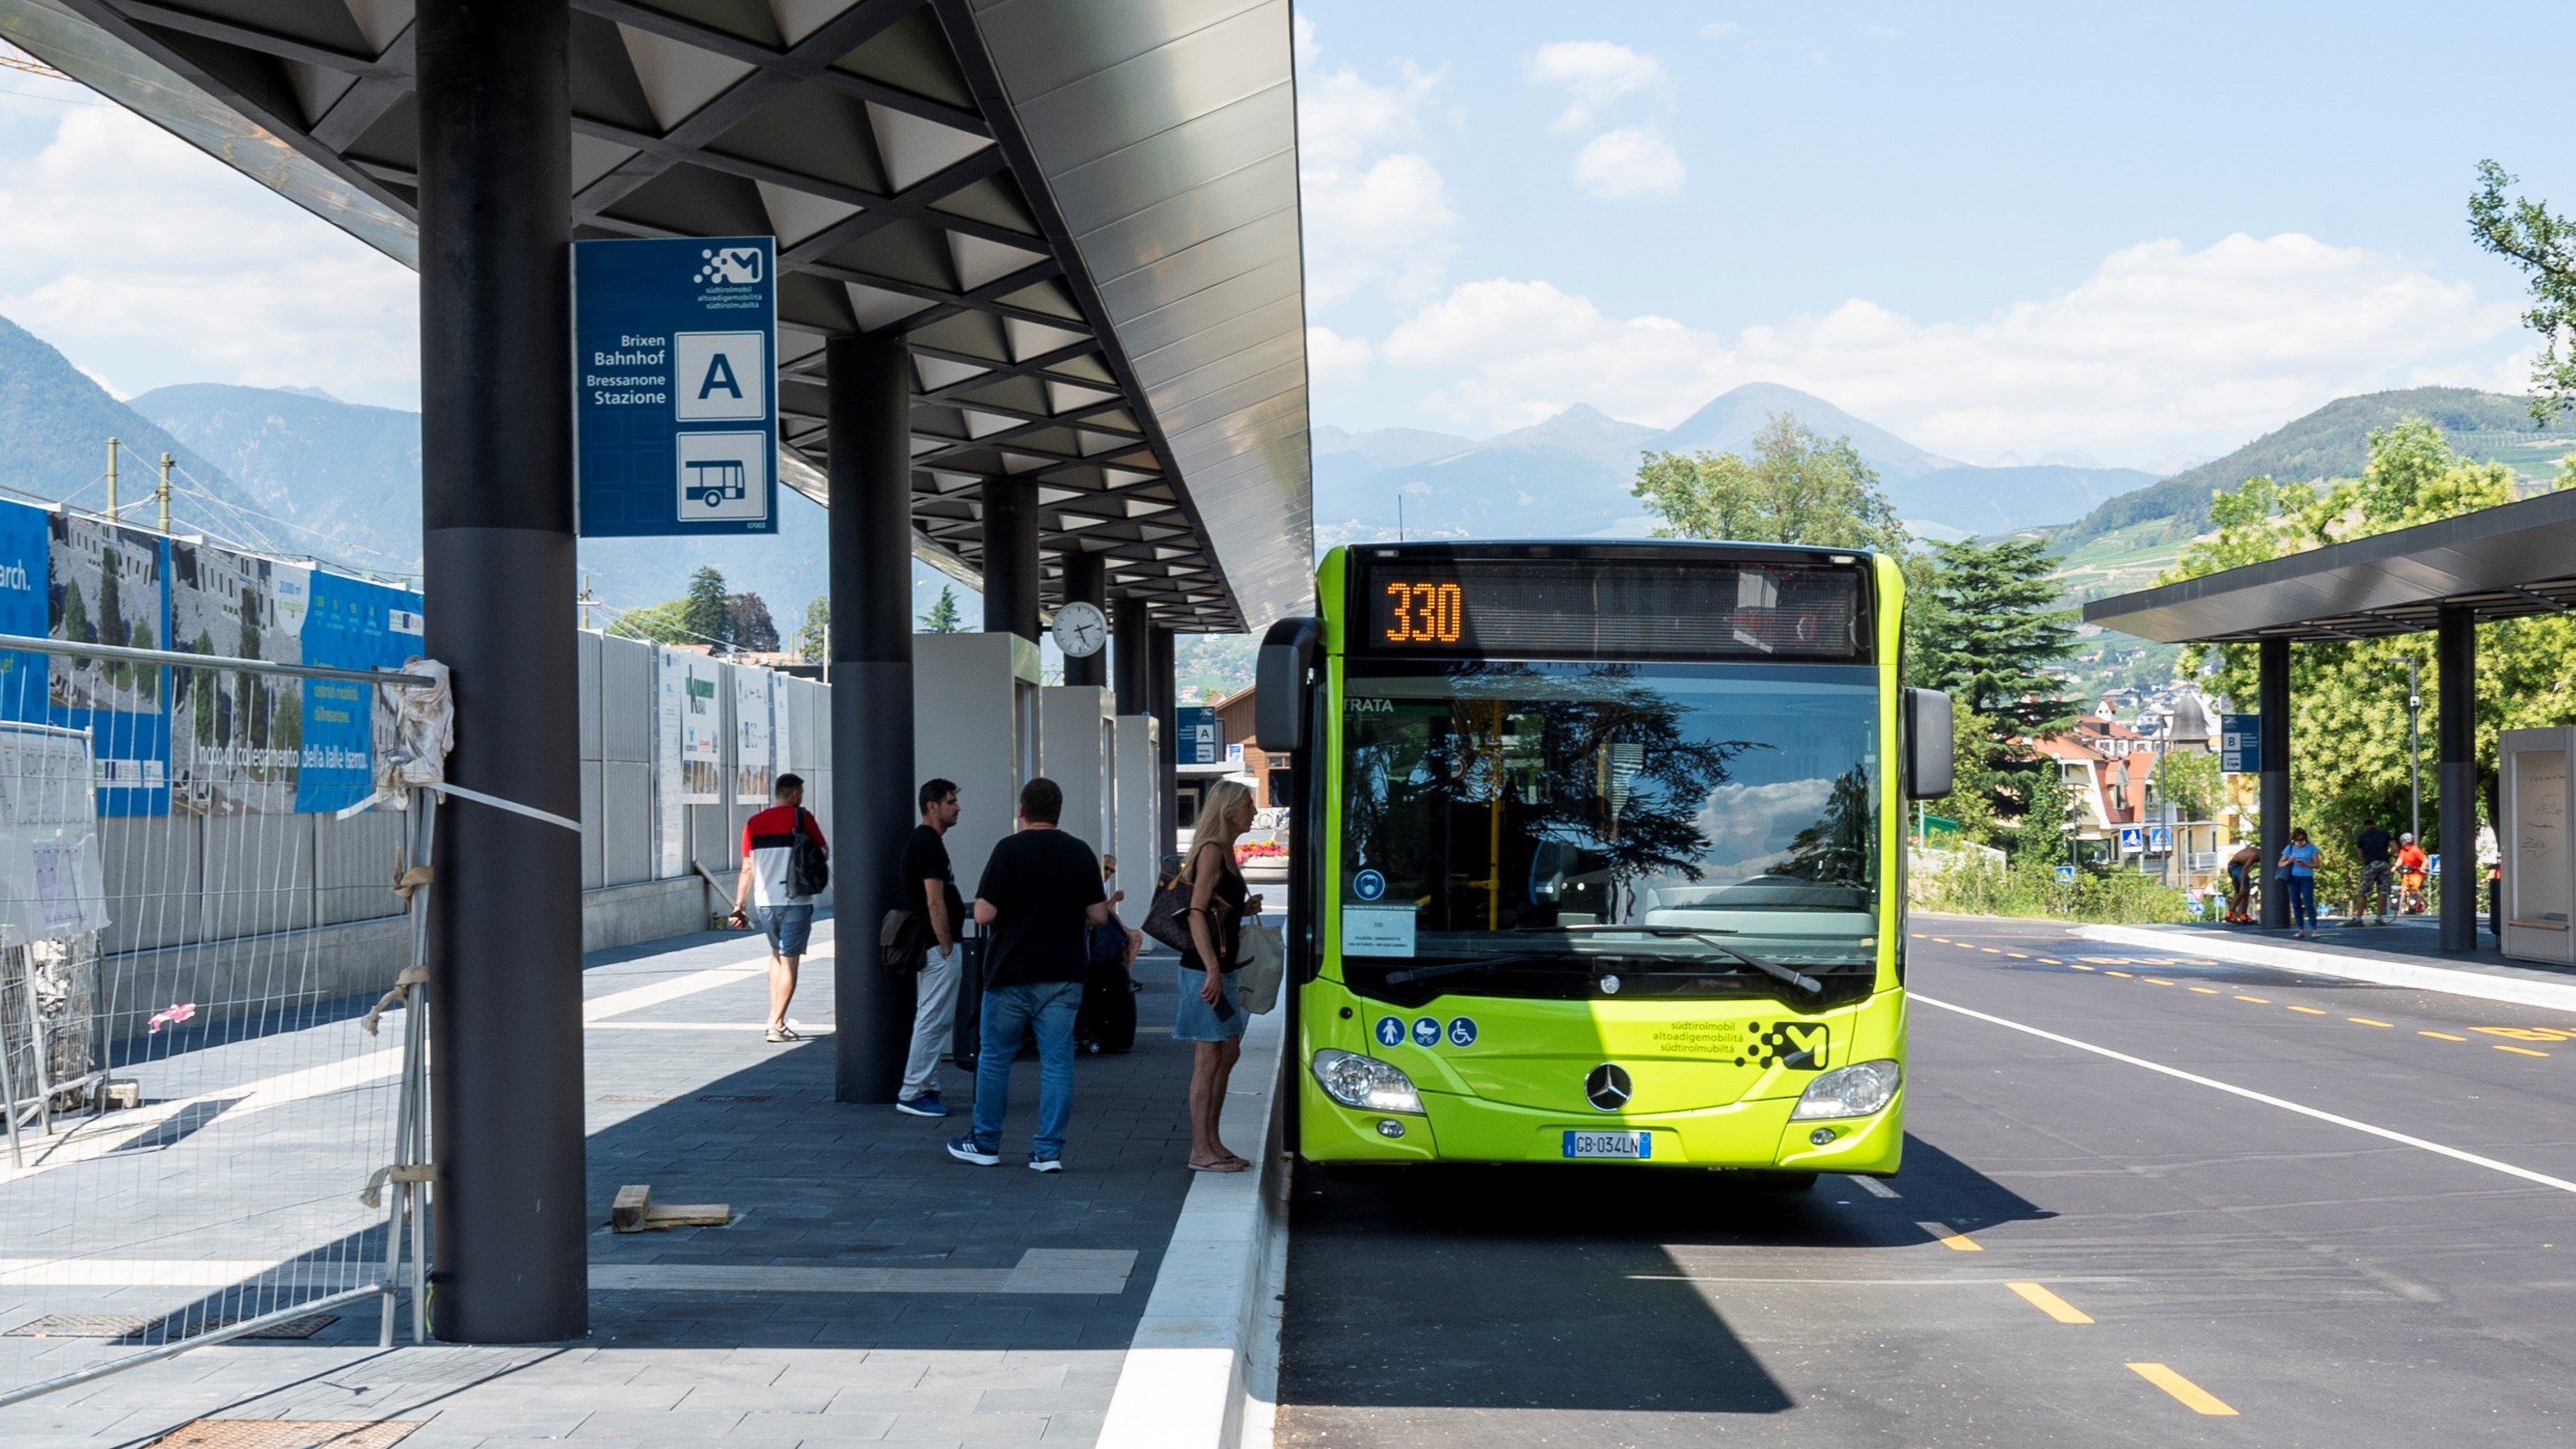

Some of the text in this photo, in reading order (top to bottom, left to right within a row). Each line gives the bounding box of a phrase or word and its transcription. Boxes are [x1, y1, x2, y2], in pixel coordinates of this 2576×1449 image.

[621, 334, 667, 347] Brixen
[594, 349, 666, 366] Bahnhof
[586, 374, 667, 387] Bressanone
[697, 353, 744, 400] A
[594, 389, 667, 405] Stazione
[1386, 582, 1461, 642] 330
[1200, 728, 1210, 739] A
[2228, 736, 2236, 747] B
[1671, 1021, 1735, 1031] südtirolmobil
[1652, 1031, 1744, 1043] altoadigemobilità
